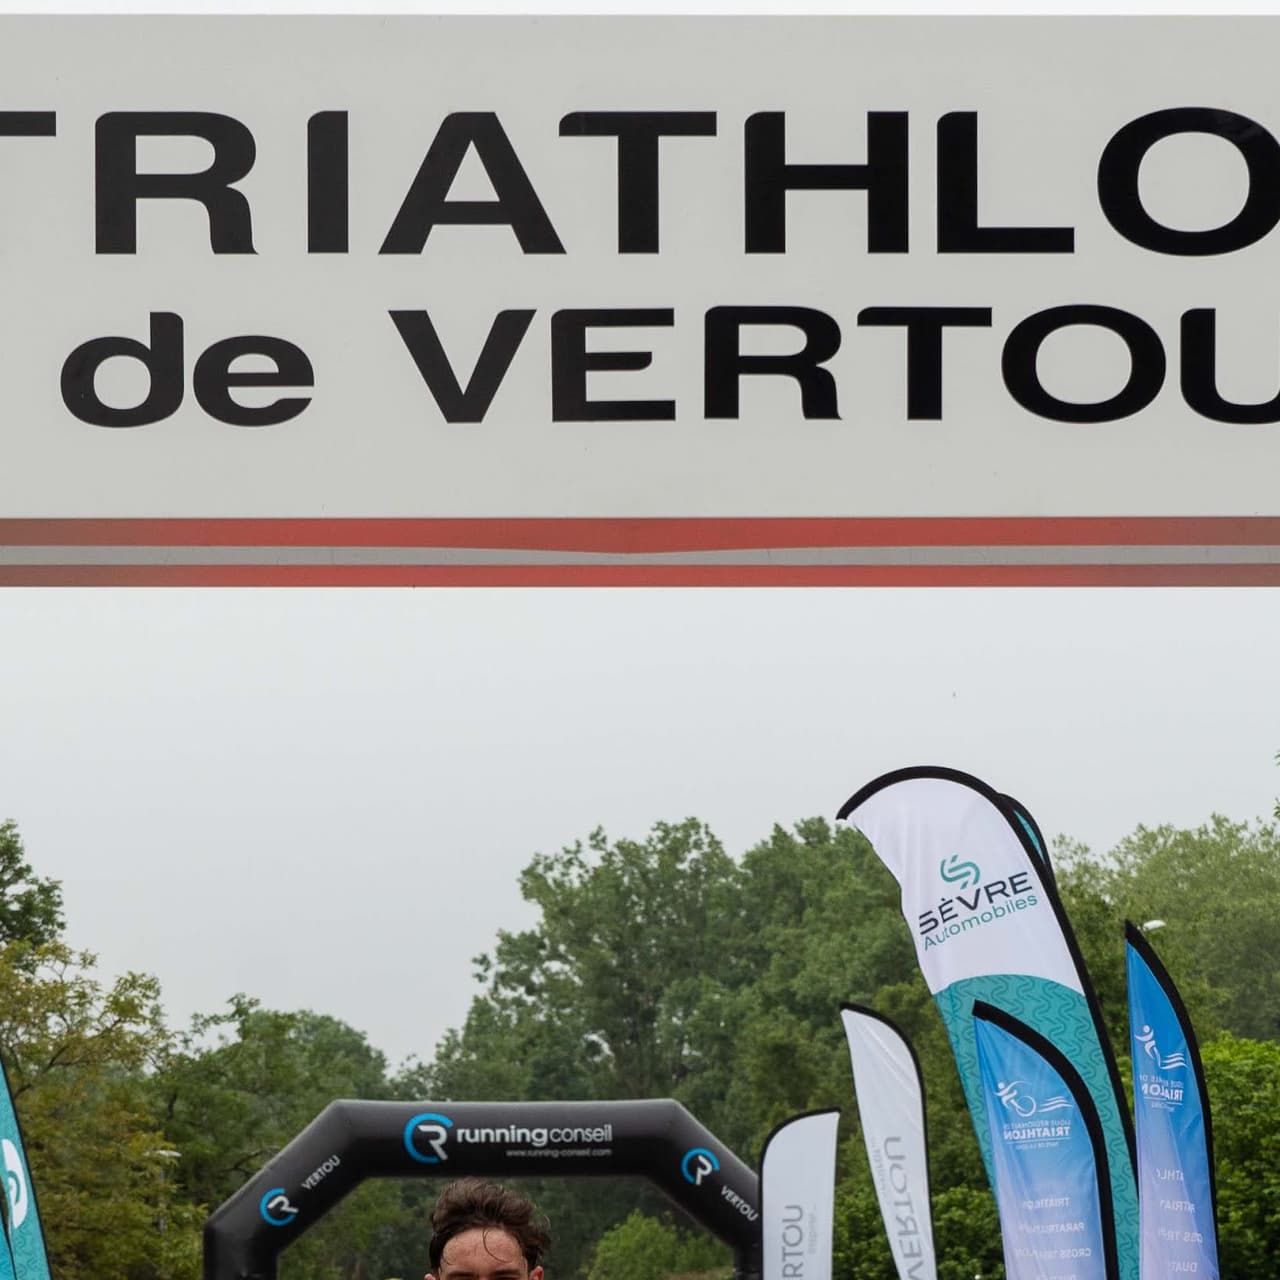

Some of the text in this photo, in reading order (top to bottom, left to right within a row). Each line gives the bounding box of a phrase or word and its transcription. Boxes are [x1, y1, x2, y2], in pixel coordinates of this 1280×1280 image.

[61, 312, 314, 428] de
[919, 872, 1032, 935] SÈVRE
[925, 894, 1038, 951] Automobiles
[301, 1154, 341, 1189] VERTOU
[720, 1185, 759, 1222] VERTOU
